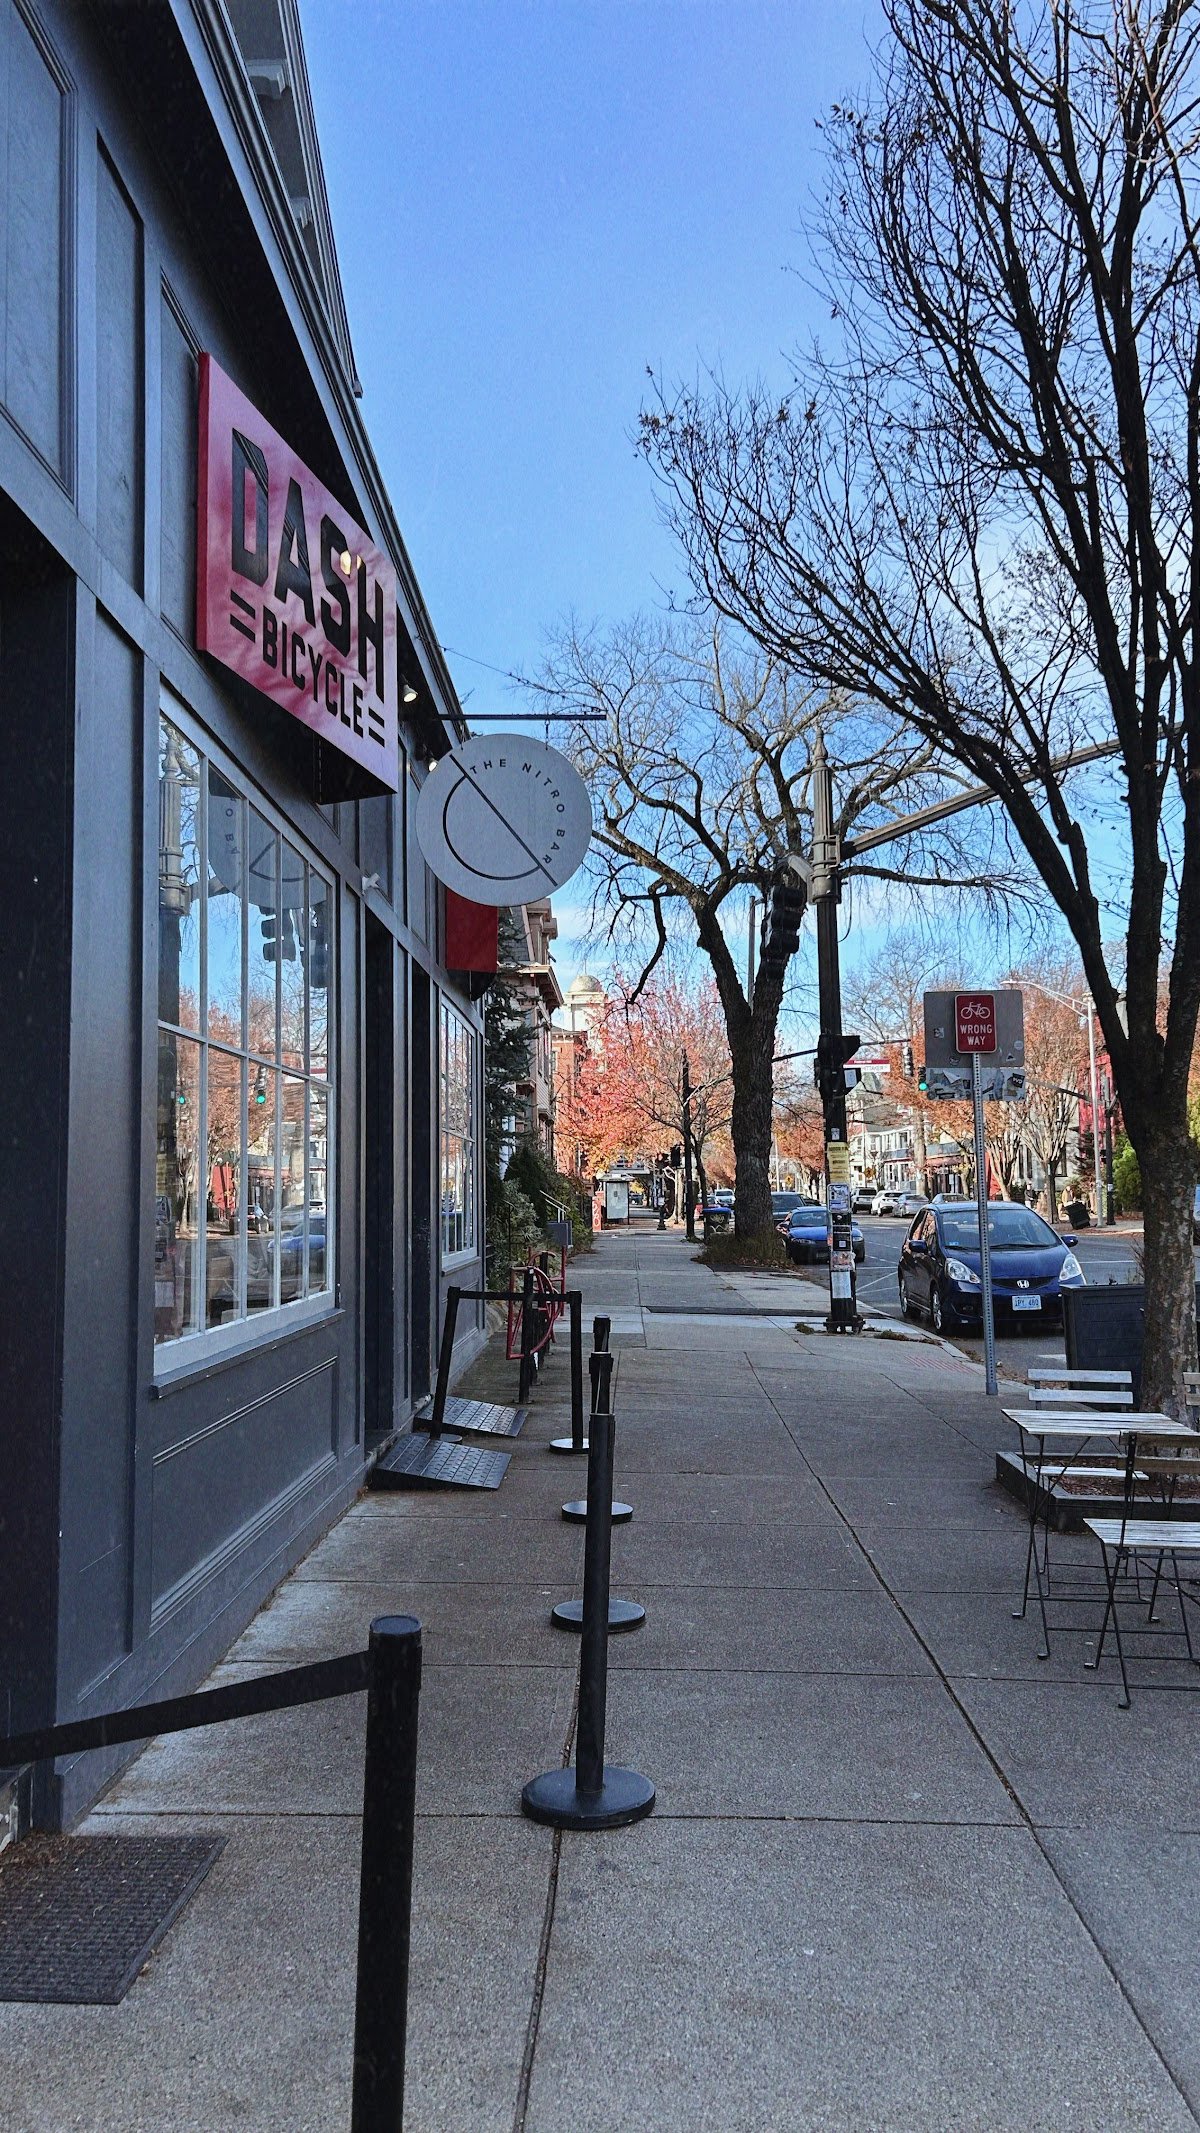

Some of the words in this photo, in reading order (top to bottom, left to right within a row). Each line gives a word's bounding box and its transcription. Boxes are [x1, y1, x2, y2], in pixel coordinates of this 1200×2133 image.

[231, 428, 385, 704] DASH
[262, 604, 364, 739] BICYCLE
[470, 759, 507, 774] THE
[522, 763, 565, 813] NITRO
[542, 829, 565, 864] BAR
[960, 1024, 993, 1034] WRONG
[967, 1036, 985, 1045] WAY
